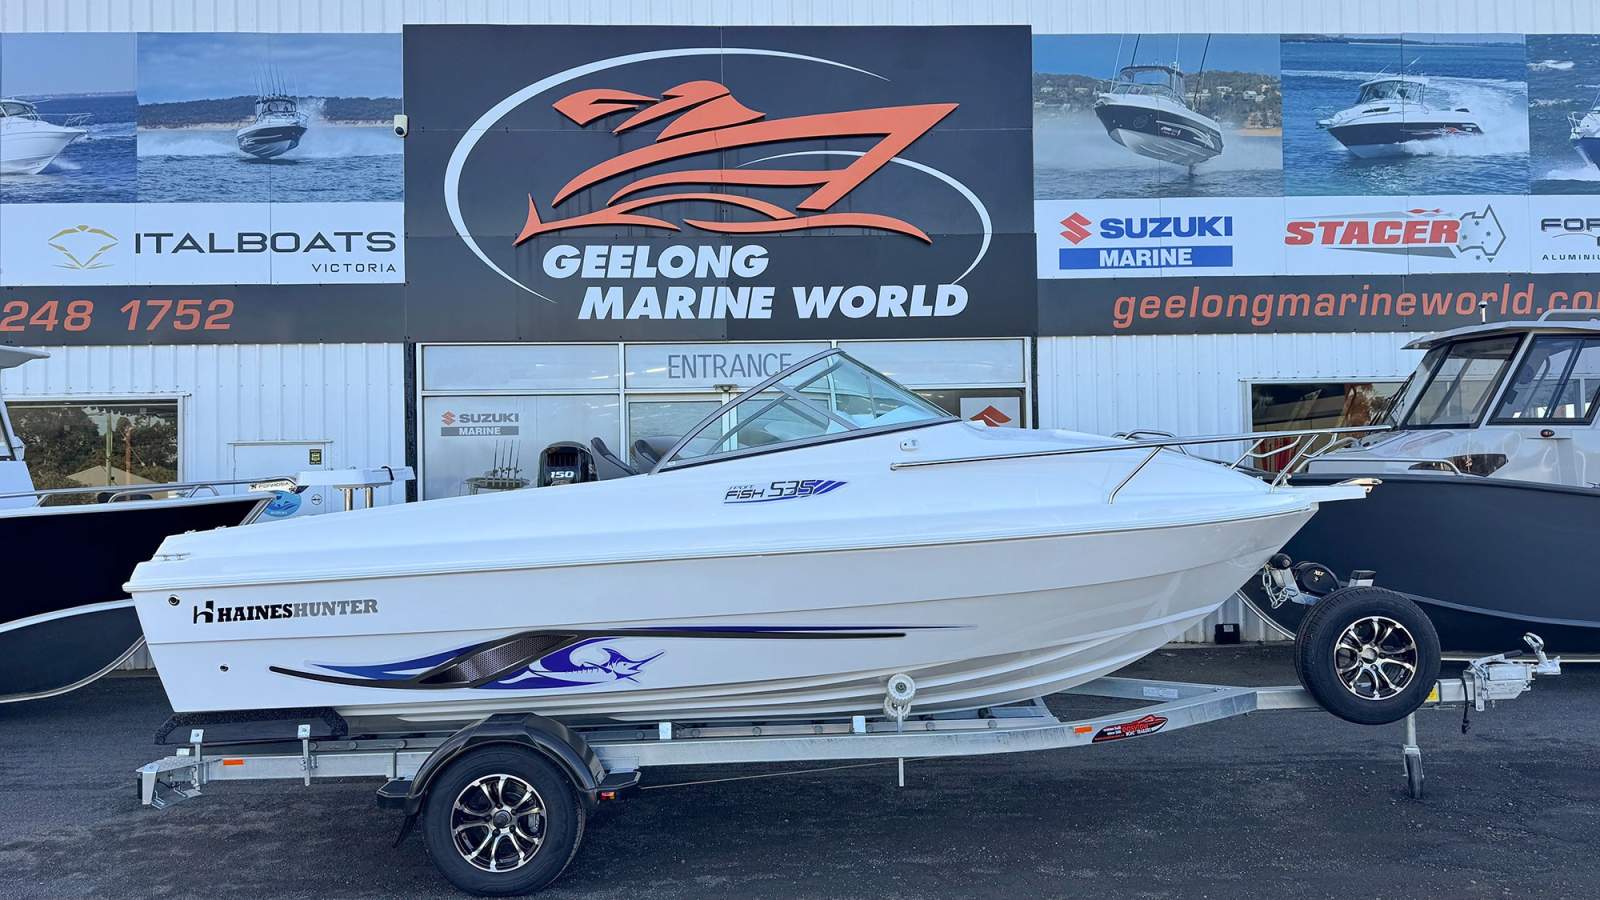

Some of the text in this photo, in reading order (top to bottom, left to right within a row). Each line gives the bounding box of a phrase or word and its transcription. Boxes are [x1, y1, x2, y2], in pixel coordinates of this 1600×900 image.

[1100, 216, 1232, 239] SUZUKI
[1284, 219, 1461, 246] STACER
[135, 231, 395, 254] ITALBOATS
[311, 263, 396, 273] VICTORIA
[542, 244, 769, 279] GEELONG
[1100, 248, 1192, 267] MARINE
[577, 284, 969, 320] MARINE WORLD
[0, 299, 234, 332] 248 1752
[668, 353, 792, 380] ENTRANCE
[459, 413, 519, 423] SUZUKI
[459, 427, 501, 435] MARINE
